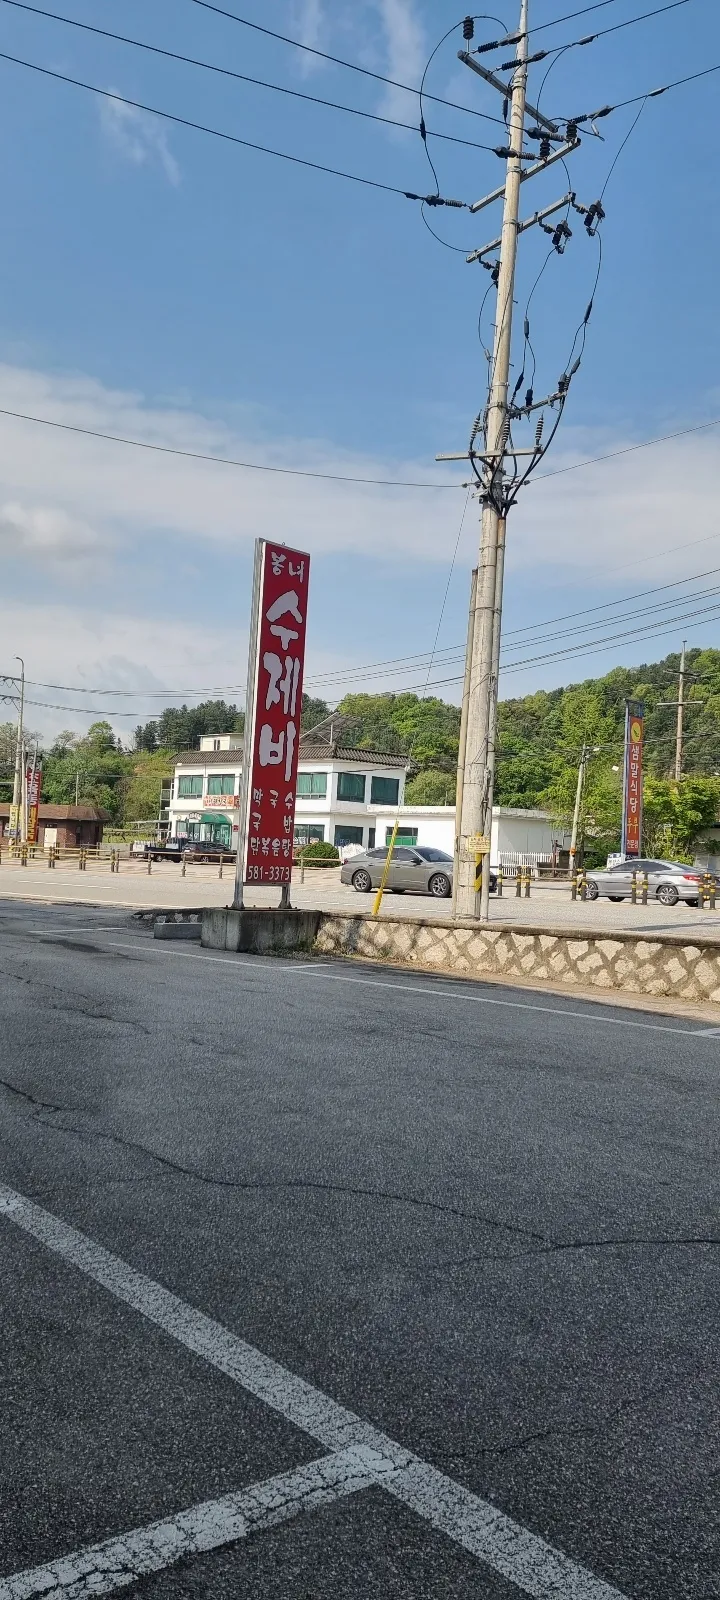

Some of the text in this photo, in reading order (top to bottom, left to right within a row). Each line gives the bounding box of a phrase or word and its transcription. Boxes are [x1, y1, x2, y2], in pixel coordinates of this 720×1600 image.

[259, 590, 303, 782] 수제비
[629, 744, 640, 813] 샘말식당
[253, 788, 294, 810] 막국수
[252, 811, 292, 834] 국밥
[250, 836, 292, 858] 닭볶음탕
[247, 865, 290, 881] 581-3373
